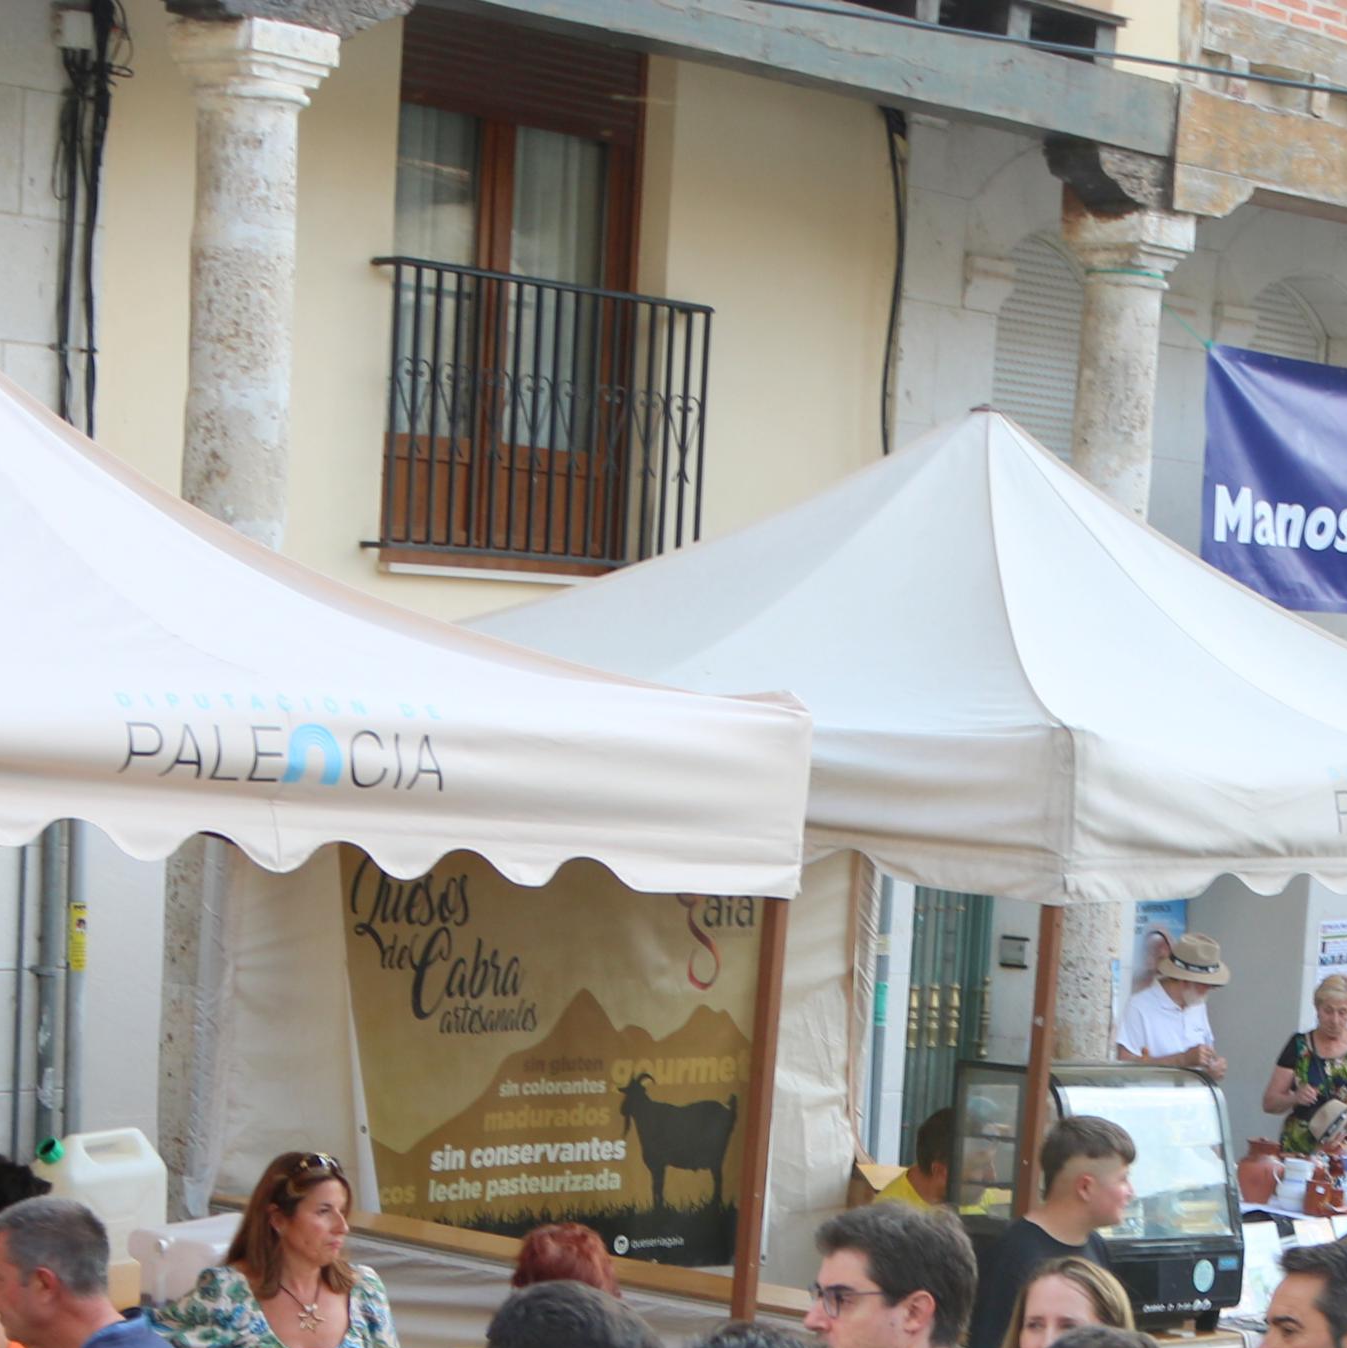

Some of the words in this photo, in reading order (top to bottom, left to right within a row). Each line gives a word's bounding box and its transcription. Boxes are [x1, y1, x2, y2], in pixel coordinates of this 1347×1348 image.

[350, 855, 470, 950] Quesos
[412, 926, 520, 1020] Cabra
[499, 1080, 520, 1098] sin
[522, 1078, 607, 1097] colorantes
[484, 1103, 611, 1132] madurados
[430, 1144, 466, 1172] sin
[470, 1136, 627, 1169] conservantes
[428, 1176, 483, 1203] leche
[485, 1168, 622, 1202] pasteurizada
